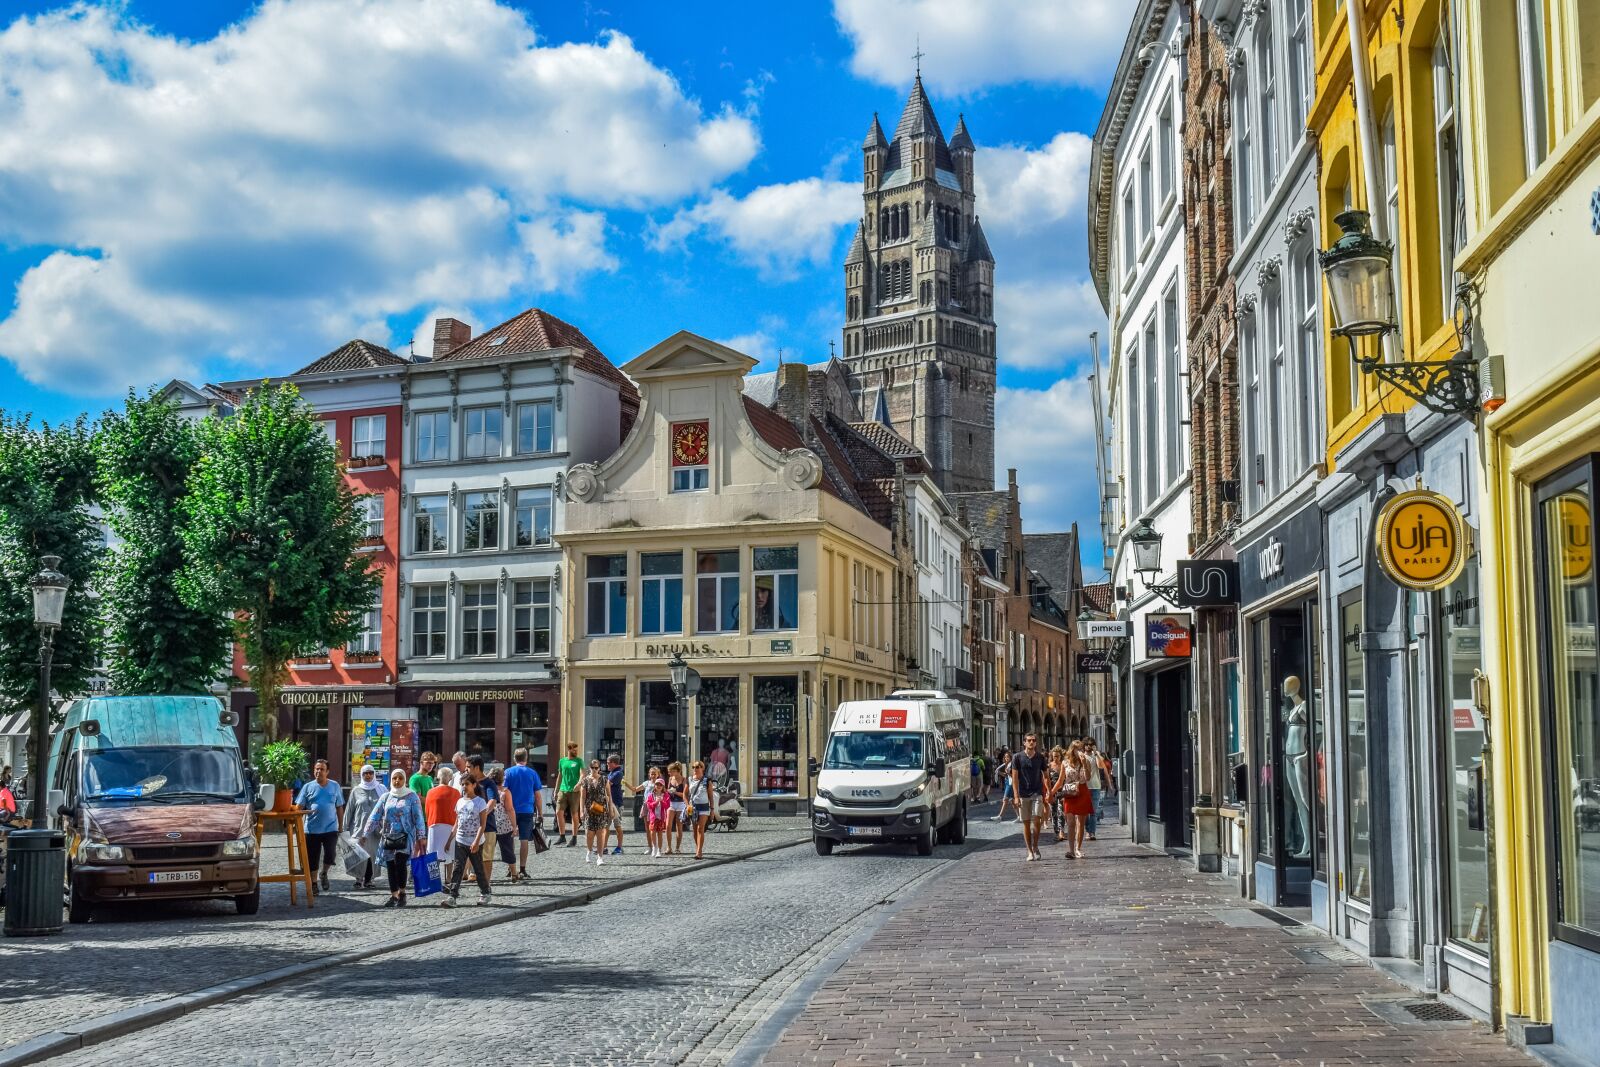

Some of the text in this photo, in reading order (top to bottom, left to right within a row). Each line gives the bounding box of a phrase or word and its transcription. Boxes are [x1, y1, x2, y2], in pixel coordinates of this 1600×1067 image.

[1404, 557, 1441, 565] PARIS
[1091, 625, 1122, 634] pimkie
[281, 692, 365, 705] CHOCOLATE LINE
[427, 690, 524, 702] by DOMINIQUE PERSOONE
[851, 789, 881, 797] IVECO
[156, 872, 200, 881] 1-TRB-156
